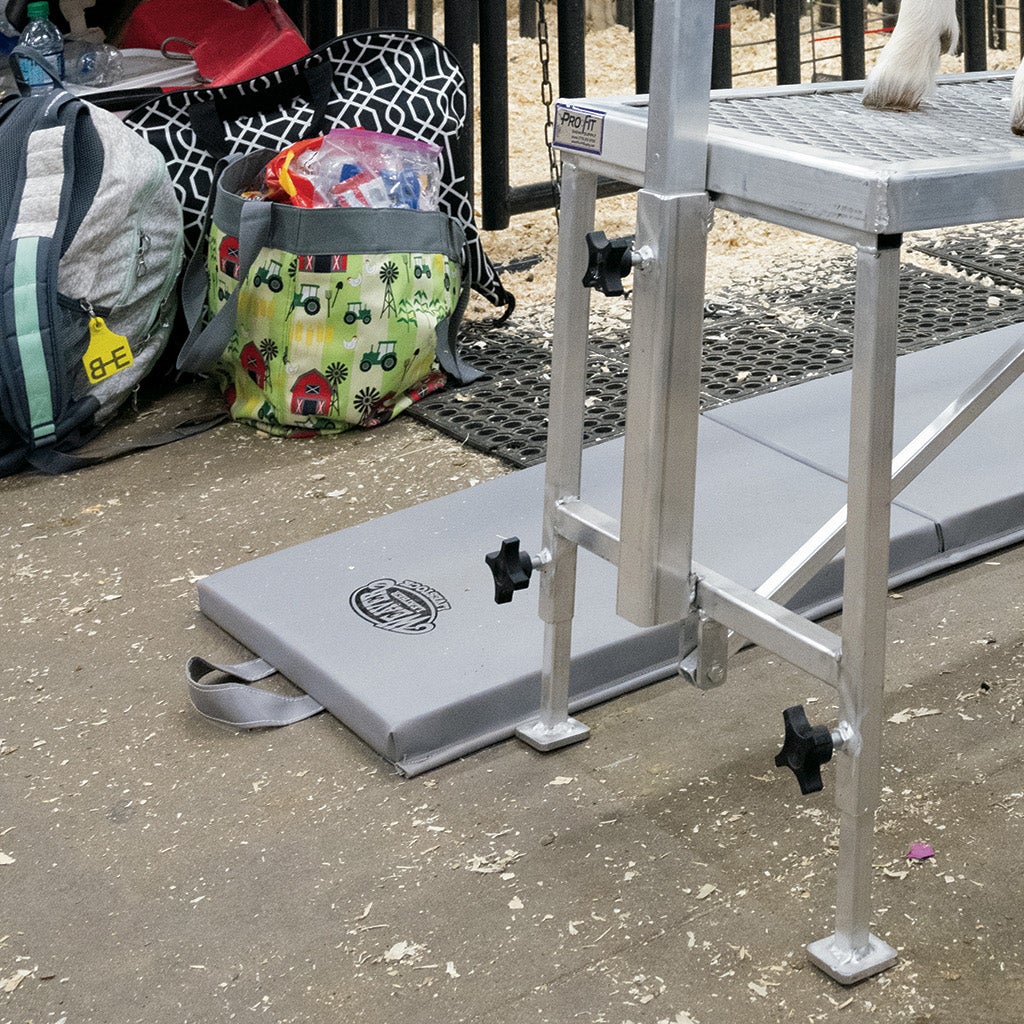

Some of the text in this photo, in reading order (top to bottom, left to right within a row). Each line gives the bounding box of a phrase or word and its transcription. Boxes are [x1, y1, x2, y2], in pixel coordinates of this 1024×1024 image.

[561, 112, 596, 134] PRO FIT
[359, 578, 436, 635] WEAVER
